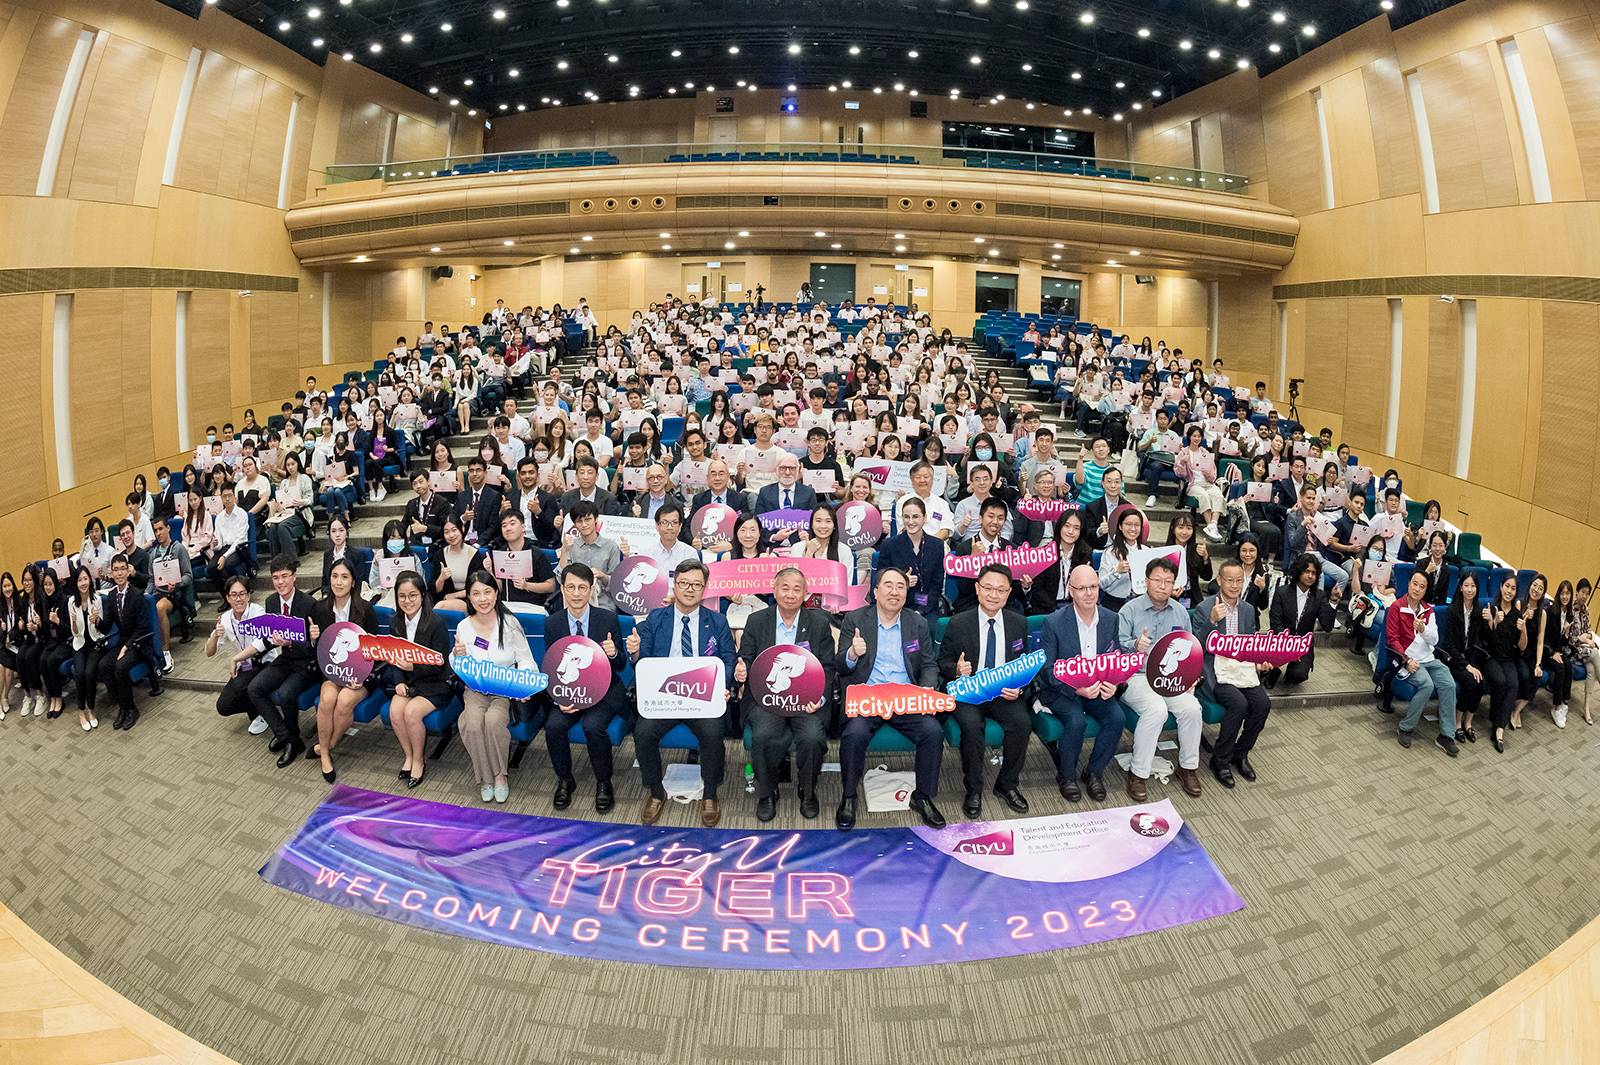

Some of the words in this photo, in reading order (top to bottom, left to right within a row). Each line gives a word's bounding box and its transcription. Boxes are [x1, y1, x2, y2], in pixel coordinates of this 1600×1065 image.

[606, 527, 639, 536] Development
[633, 522, 655, 530] Educatio
[759, 517, 809, 531] ityULeade
[701, 532, 726, 545] CityU
[847, 532, 870, 546] CityU
[945, 543, 1057, 575] Congratulations!
[738, 564, 768, 573] CITYU
[708, 579, 760, 589] ELCOMING
[762, 578, 817, 588] CENY
[819, 577, 839, 586] 2023
[615, 592, 645, 607] CityU
[1208, 630, 1312, 656] Congratulations!
[361, 645, 442, 664] #CityUElites
[325, 663, 354, 678] CityU
[1056, 651, 1145, 677] #CityUTiger
[454, 657, 547, 688] #CityUInnovators
[950, 652, 1046, 698] #CityUInnovators
[665, 681, 707, 698] CityU
[1154, 676, 1182, 691] CityU
[553, 685, 586, 700] CityU
[762, 694, 799, 708] CityU
[785, 704, 805, 712] TIGER
[847, 693, 955, 718] #CityUElites
[1020, 826, 1047, 834] Talent
[1048, 823, 1065, 832] and
[1065, 819, 1108, 829] Education
[1023, 830, 1082, 841] Development
[1083, 827, 1109, 835] Office
[959, 841, 1006, 855] CityU
[543, 858, 855, 919] TIGER
[315, 866, 602, 942] WELCOMING
[638, 921, 969, 953] CEREMONY
[1006, 900, 1137, 939] 2023
